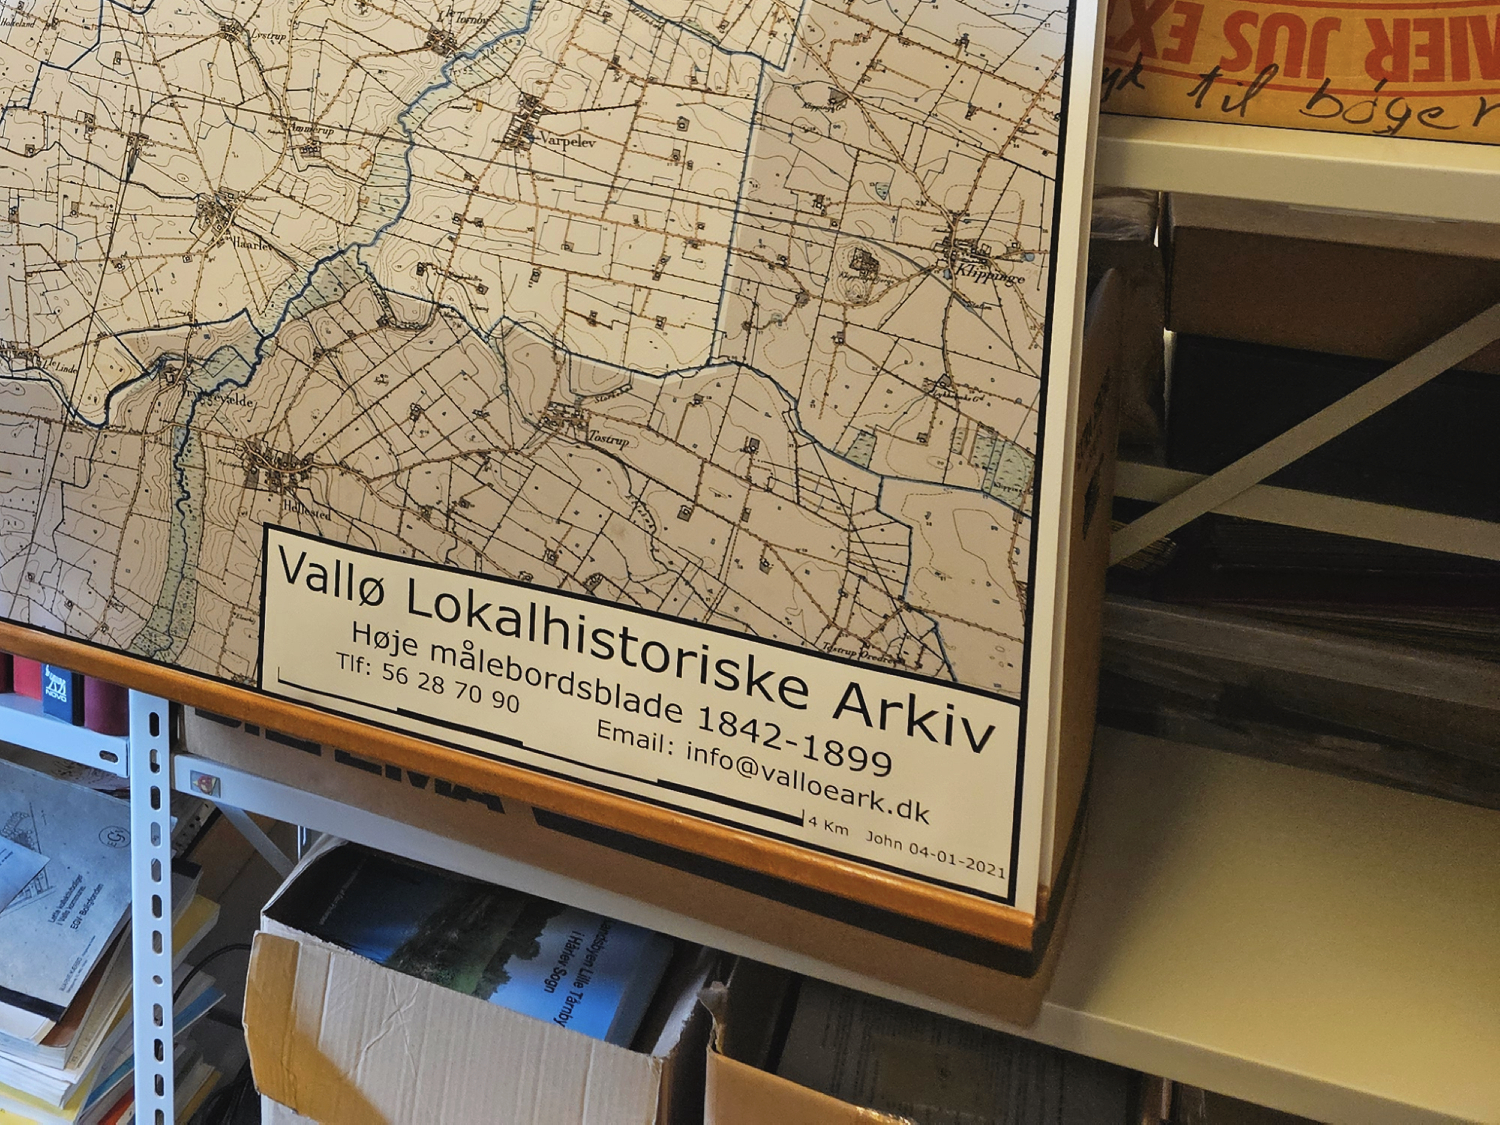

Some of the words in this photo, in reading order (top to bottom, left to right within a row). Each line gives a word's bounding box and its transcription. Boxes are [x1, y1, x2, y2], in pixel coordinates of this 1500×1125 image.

[1219, 8, 1343, 81] JUS
[1187, 62, 1280, 118] til
[537, 130, 597, 152] Varpelev
[955, 263, 1026, 286] Klippinge
[278, 544, 385, 608] Vallø
[408, 577, 810, 710] Lokalhistoriske
[832, 681, 997, 754] Arkiv
[45, 688, 67, 703] NOVO
[336, 651, 372, 676] Tlf:
[382, 663, 409, 686] 56
[418, 672, 445, 695] 28
[454, 680, 482, 704] 70
[492, 690, 520, 714] 90
[353, 620, 419, 657] Høje
[431, 640, 684, 724] målebordsblade
[698, 706, 893, 778] 1842-1899
[597, 718, 675, 756] Email:
[687, 741, 932, 826] info@valloeark.dk
[808, 815, 819, 829] 4
[823, 820, 850, 837] Km
[865, 829, 904, 852] John
[909, 841, 1007, 880] 04-01-2021
[544, 967, 568, 995] Sogn
[573, 967, 594, 990] Lille
[553, 990, 585, 1029] Tårnby
